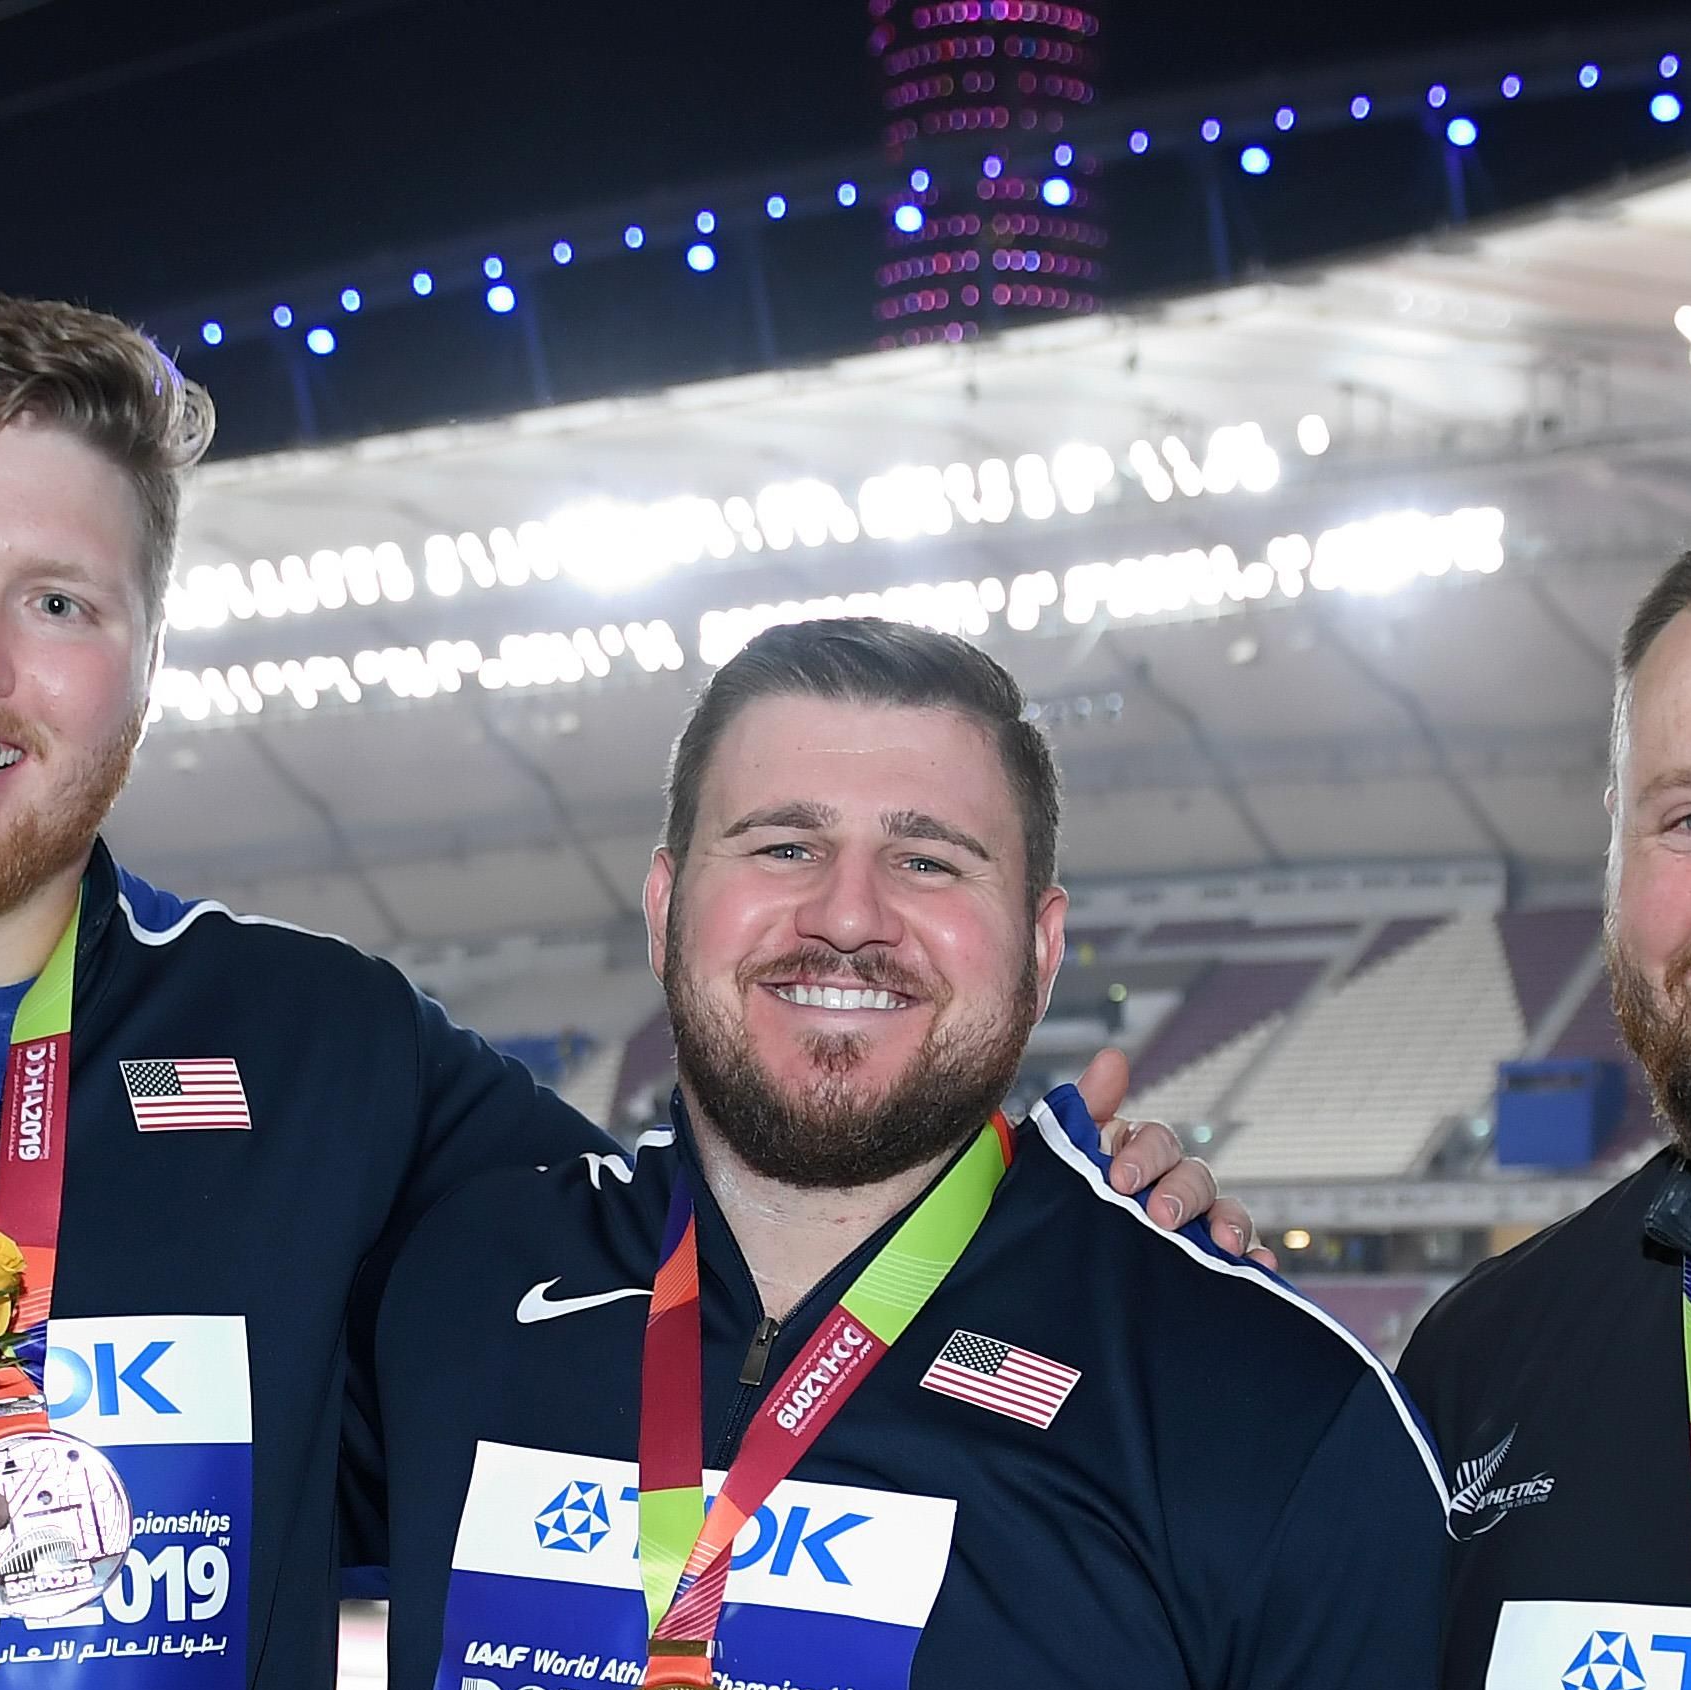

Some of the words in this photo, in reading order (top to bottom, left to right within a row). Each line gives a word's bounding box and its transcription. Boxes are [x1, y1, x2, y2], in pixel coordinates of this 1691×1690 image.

[18, 1043, 47, 1161] DOHA2019
[776, 1323, 866, 1430] DOHA2019
[1474, 1478, 1556, 1513] ATHLETICS
[132, 1510, 230, 1537] pionships
[464, 1641, 531, 1668] IAAF
[533, 1649, 600, 1678] World
